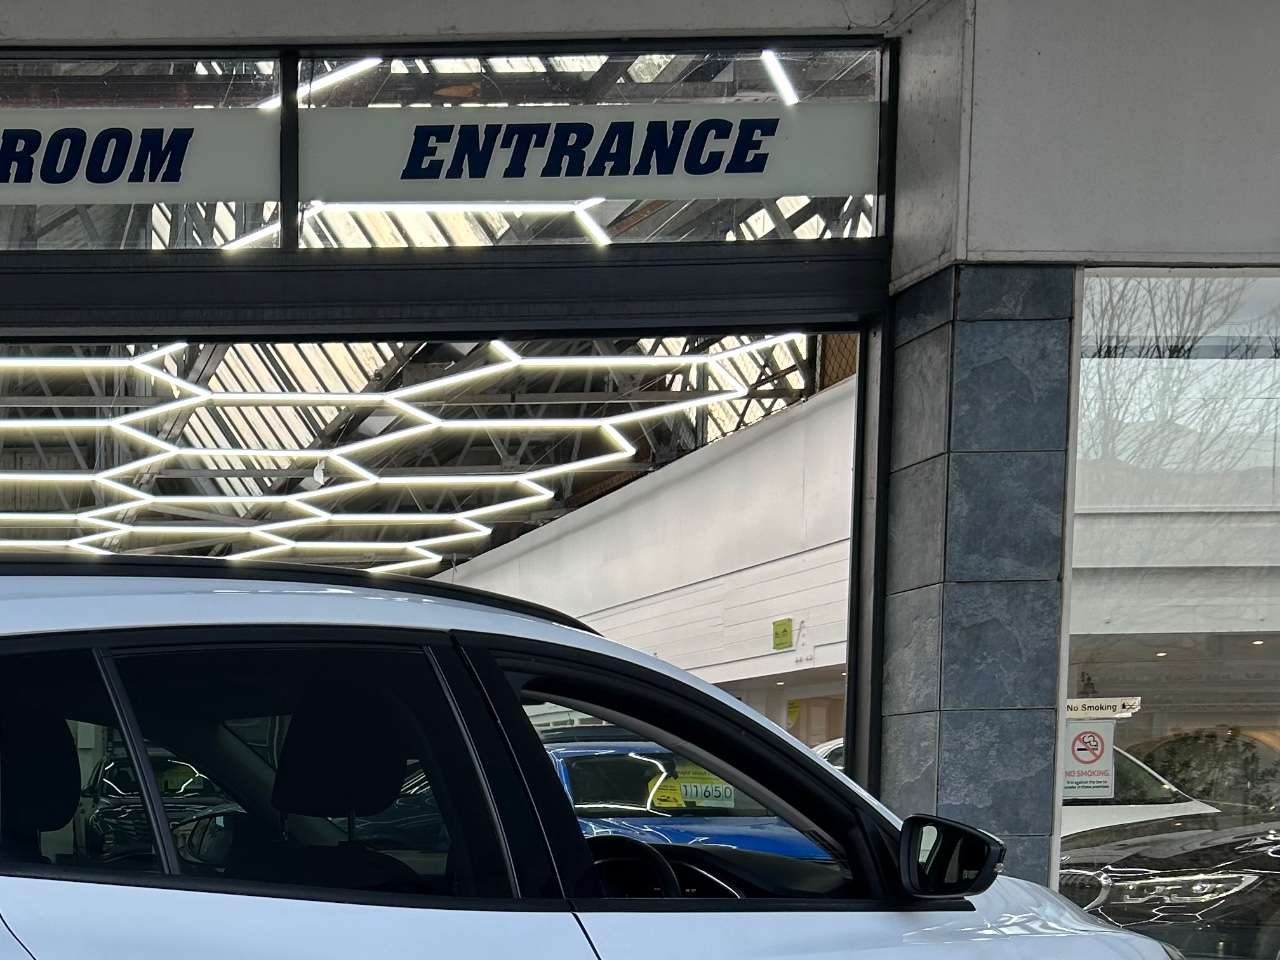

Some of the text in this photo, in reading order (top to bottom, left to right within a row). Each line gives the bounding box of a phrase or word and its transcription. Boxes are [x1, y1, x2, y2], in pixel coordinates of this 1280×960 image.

[400, 118, 780, 180] ENTRANCE
[1066, 703, 1117, 712] No Smoking
[1075, 769, 1110, 777] SMOKING
[682, 784, 732, 799] 11650
